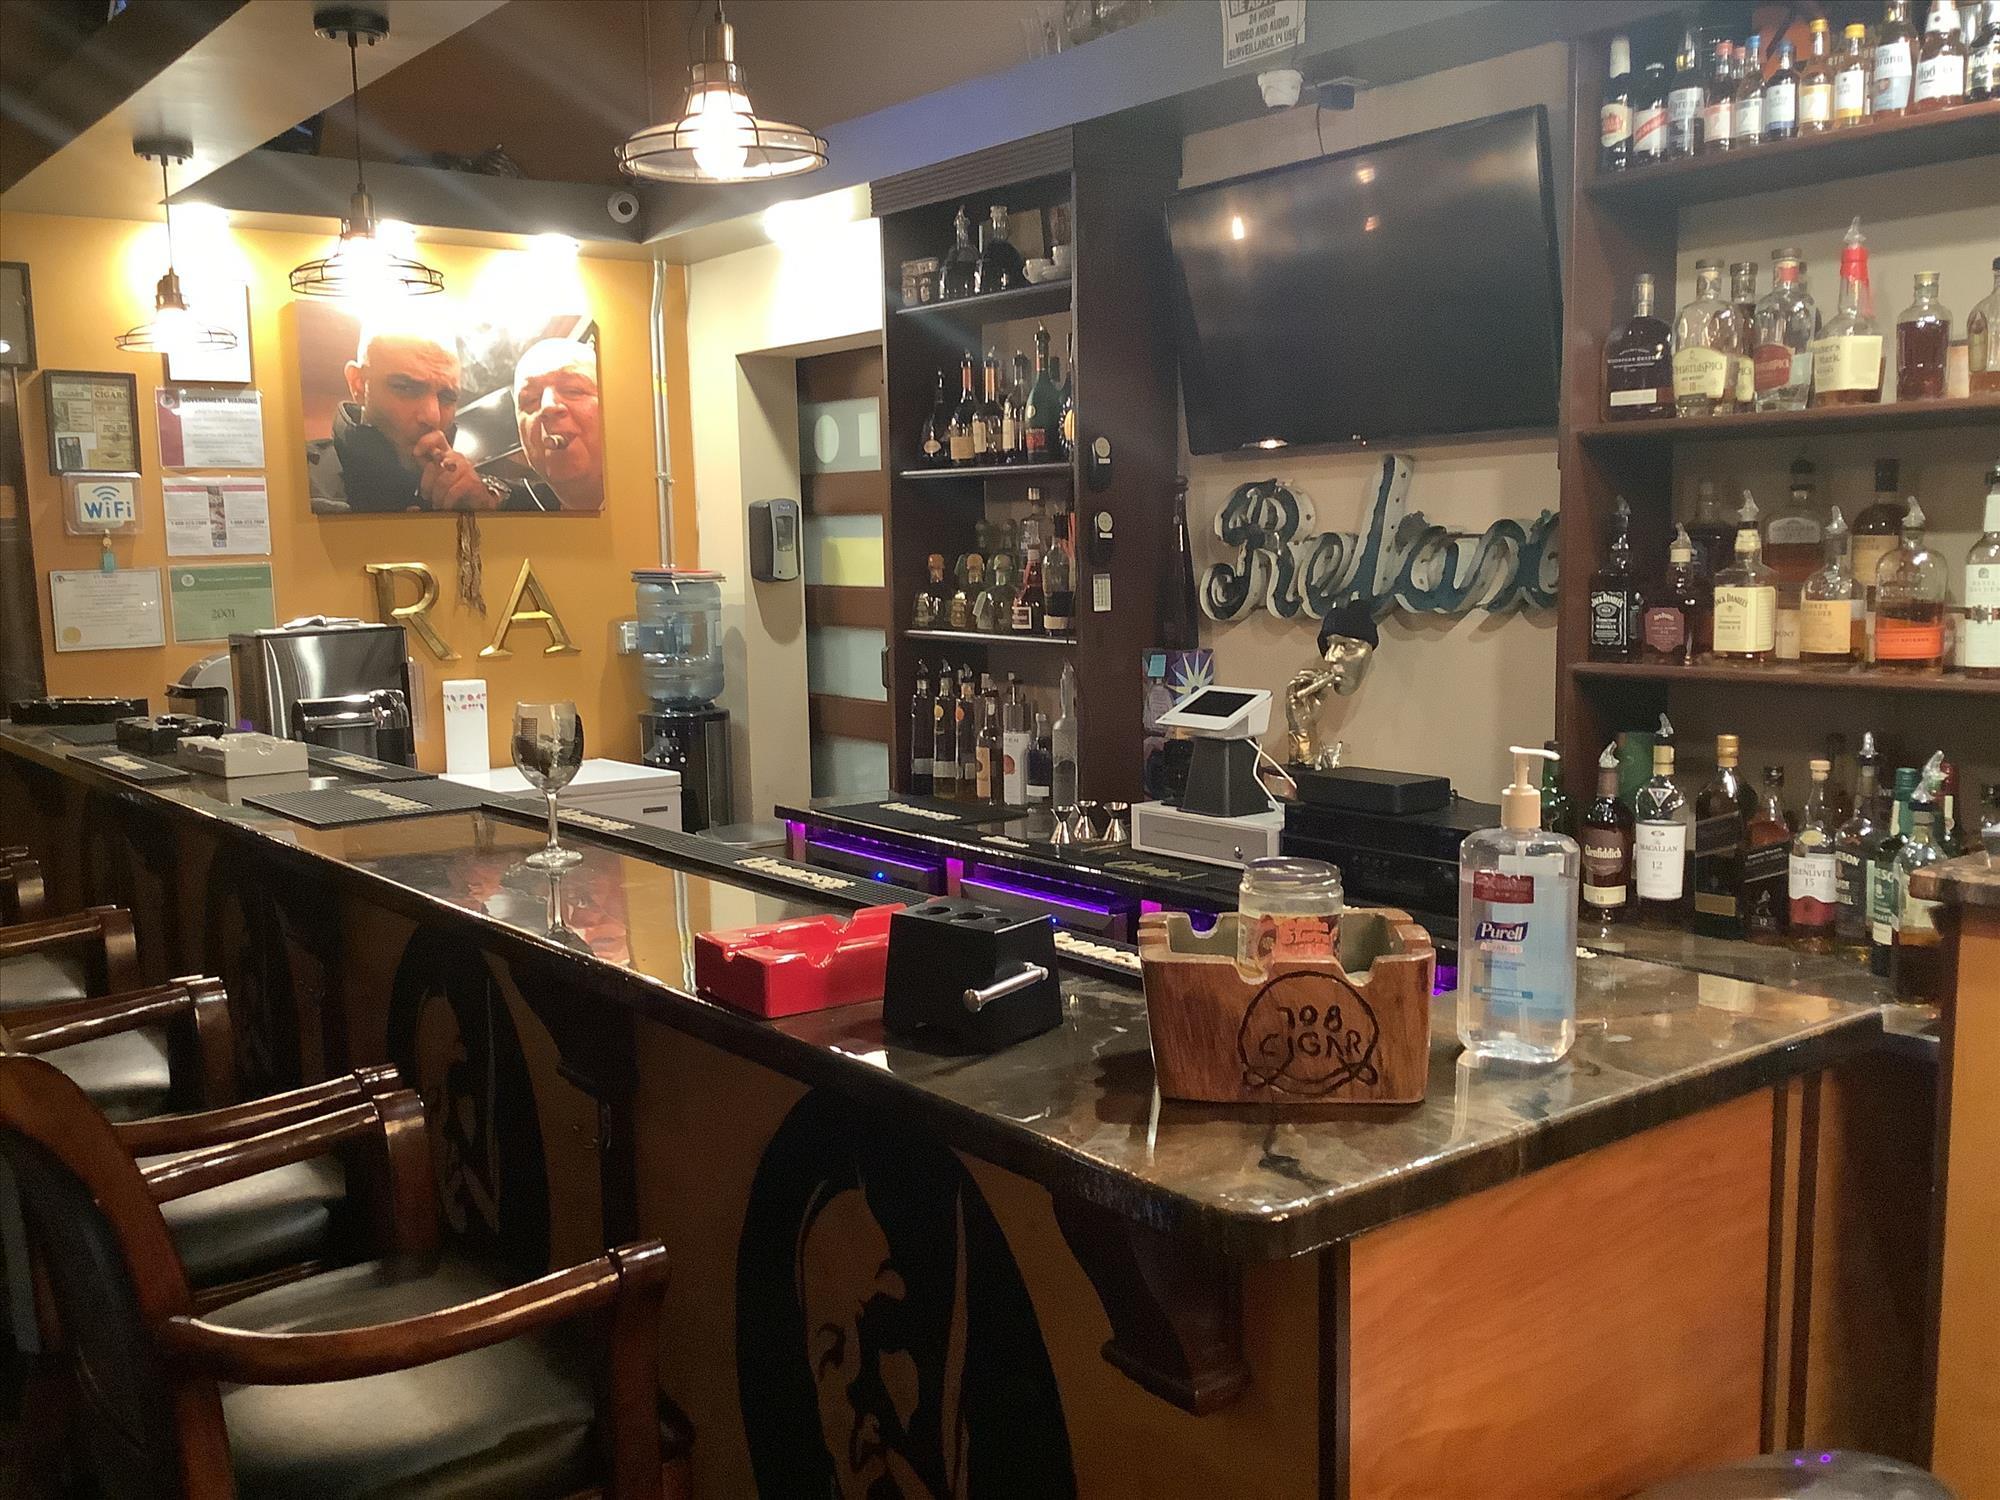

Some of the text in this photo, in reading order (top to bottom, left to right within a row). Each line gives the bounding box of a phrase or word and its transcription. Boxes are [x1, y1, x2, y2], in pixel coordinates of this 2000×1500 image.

[1249, 6, 1276, 25] 24 HOUR
[1235, 15, 1290, 43] VIDEO AND AUDIO
[1229, 35, 1275, 61] SURVEILLANCE
[94, 391, 128, 400] CIGARS
[182, 396, 226, 404] GOVERNMENT
[84, 501, 132, 519] WiFi
[211, 608, 237, 619] 2001
[1585, 844, 1622, 859] Glenfiddich
[1638, 844, 1678, 853] MACALLAN
[1651, 860, 1663, 870] 12
[1791, 868, 1833, 879] GLENLIVET
[1804, 879, 1816, 888] 15
[1480, 922, 1524, 941] Purell
